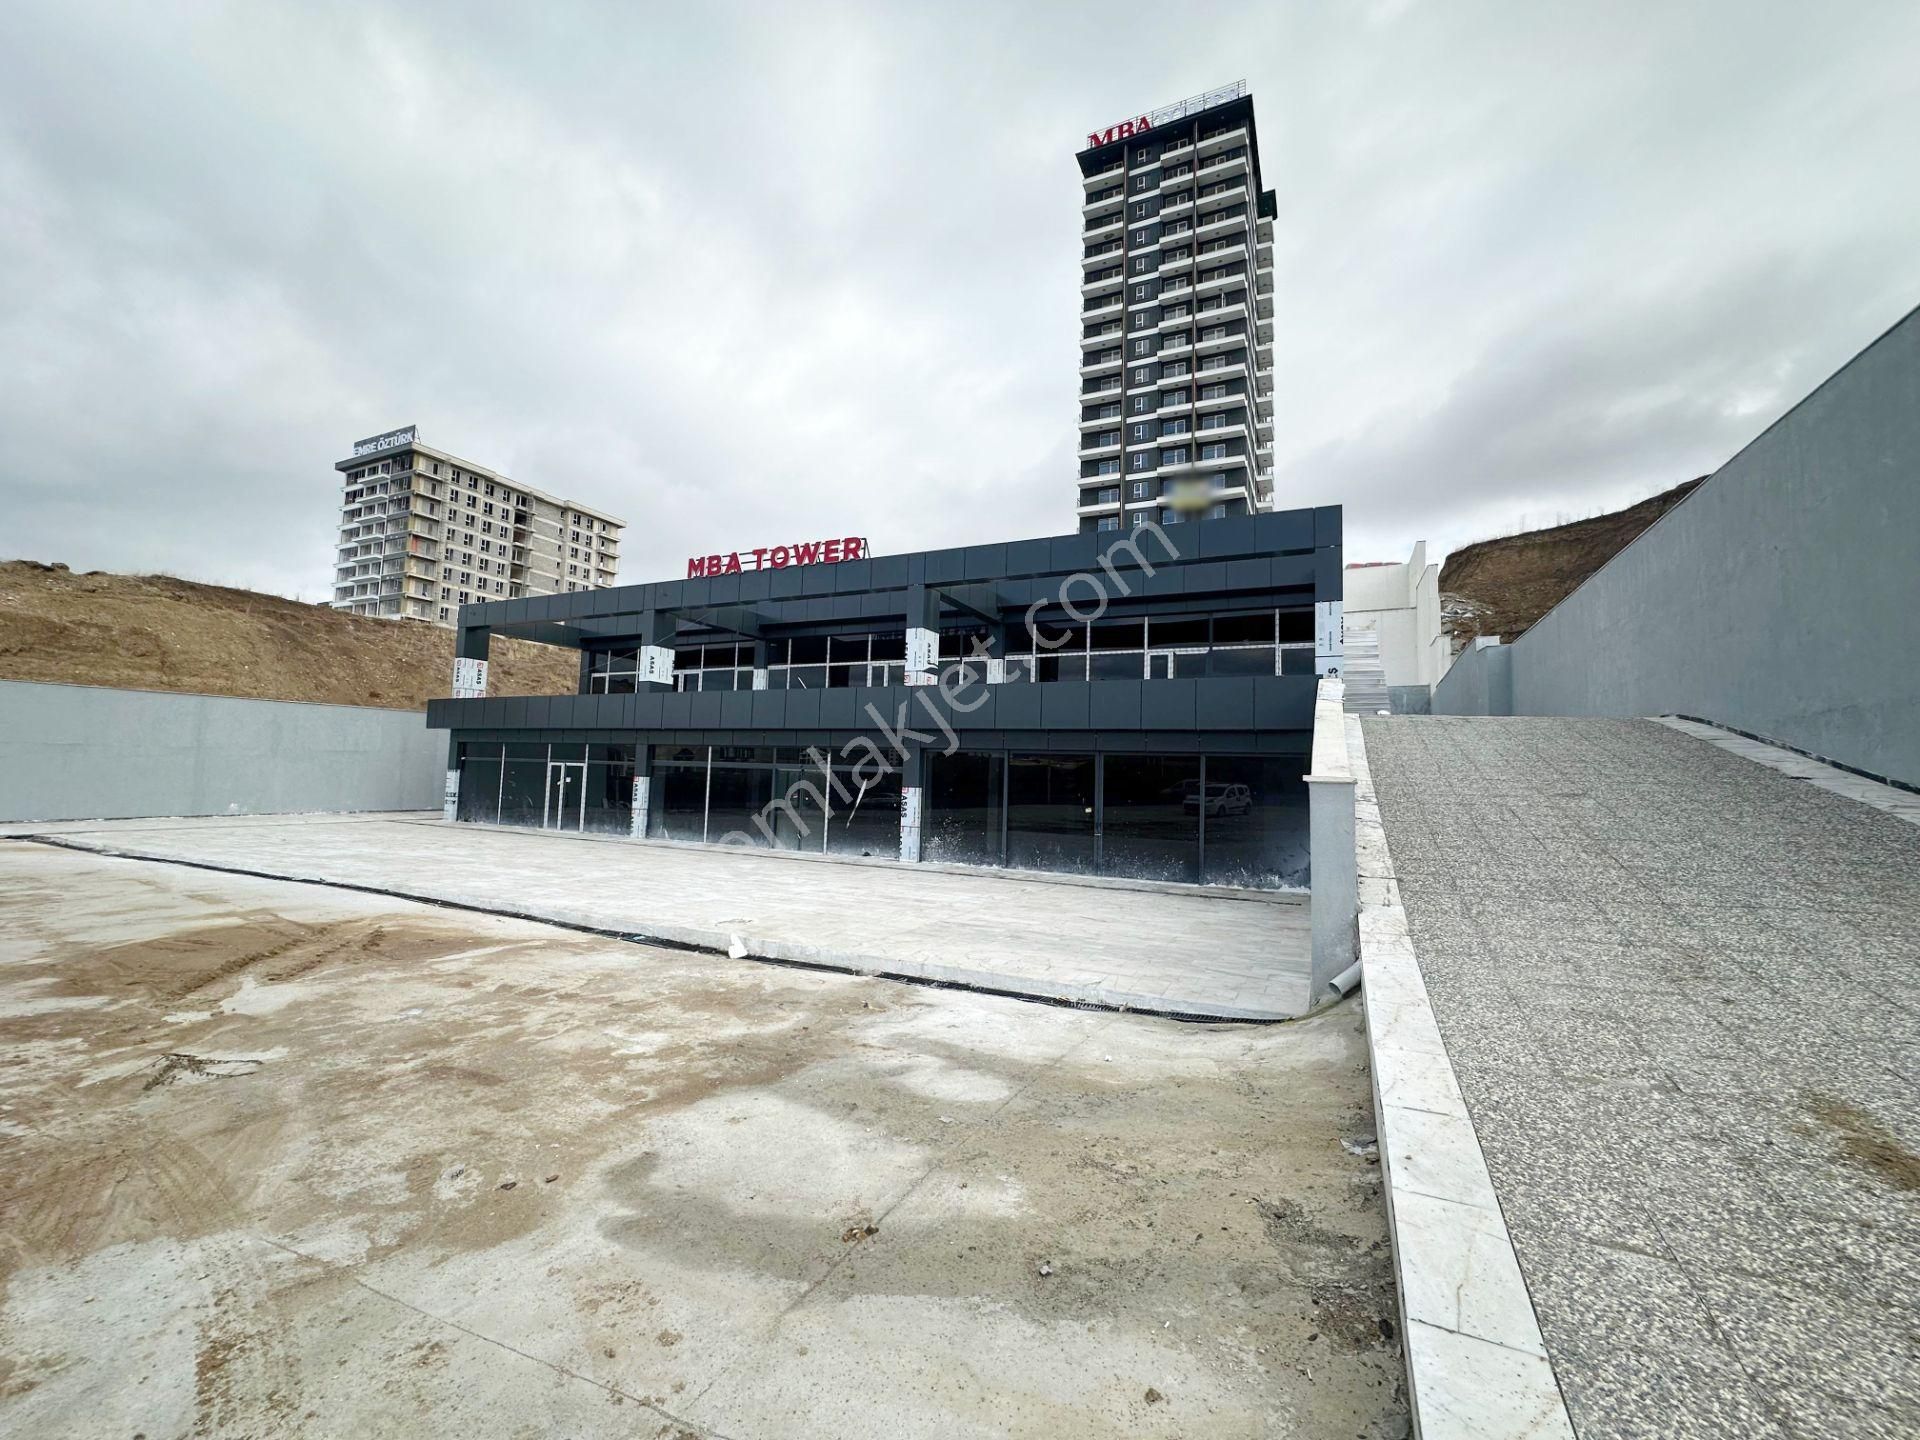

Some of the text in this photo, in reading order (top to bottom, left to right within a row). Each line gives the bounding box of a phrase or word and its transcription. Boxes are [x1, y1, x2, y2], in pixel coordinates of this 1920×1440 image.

[1089, 116, 1153, 147] MBA
[353, 431, 414, 456] EMRE ÖZTÜRK
[687, 537, 862, 578] MBA TOWER
